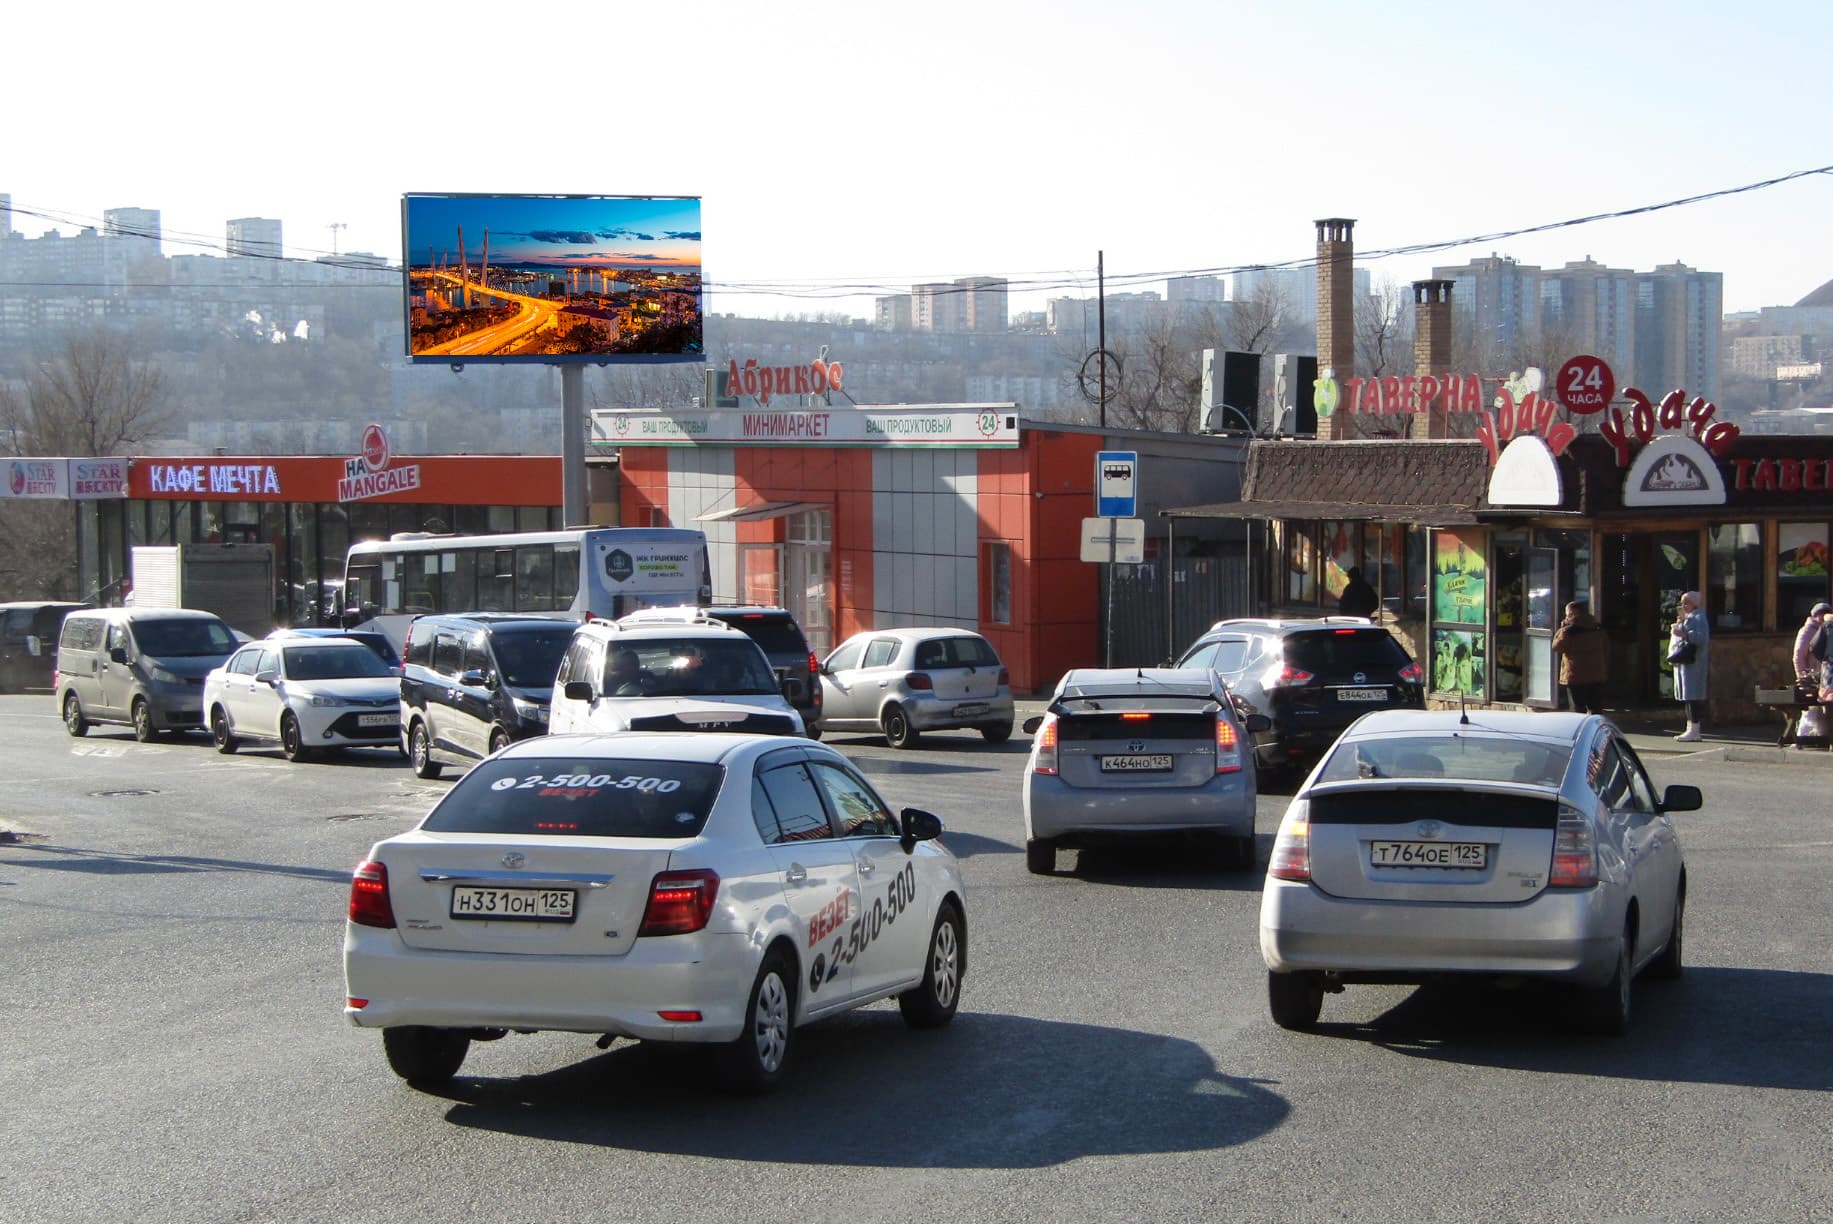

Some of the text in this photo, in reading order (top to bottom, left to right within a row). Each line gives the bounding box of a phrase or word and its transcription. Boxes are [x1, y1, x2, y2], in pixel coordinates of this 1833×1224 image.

[1567, 366, 1603, 391] 24
[1346, 372, 1484, 417] ТАВЕРНА
[1567, 393, 1603, 404] ЧАСА
[617, 416, 628, 430] 24
[642, 419, 708, 435] ВАШ ПРОДУКТОВЫЙ
[743, 414, 830, 437] МИНИМАРКЕТ
[866, 417, 952, 435] ВАШ ПРОДУКТОВЫЙ
[982, 415, 996, 430] 24
[346, 459, 365, 477] НА
[151, 465, 281, 494] КАФЕ МЕЧТА
[339, 467, 417, 499] MANGALE
[1105, 756, 1169, 769] К464НО 125
[515, 774, 681, 793] 2-500-500
[1378, 844, 1481, 863] Т764ОЕ 125
[459, 891, 569, 912] Н331ОН 125
[825, 860, 916, 985] 2-500-500
